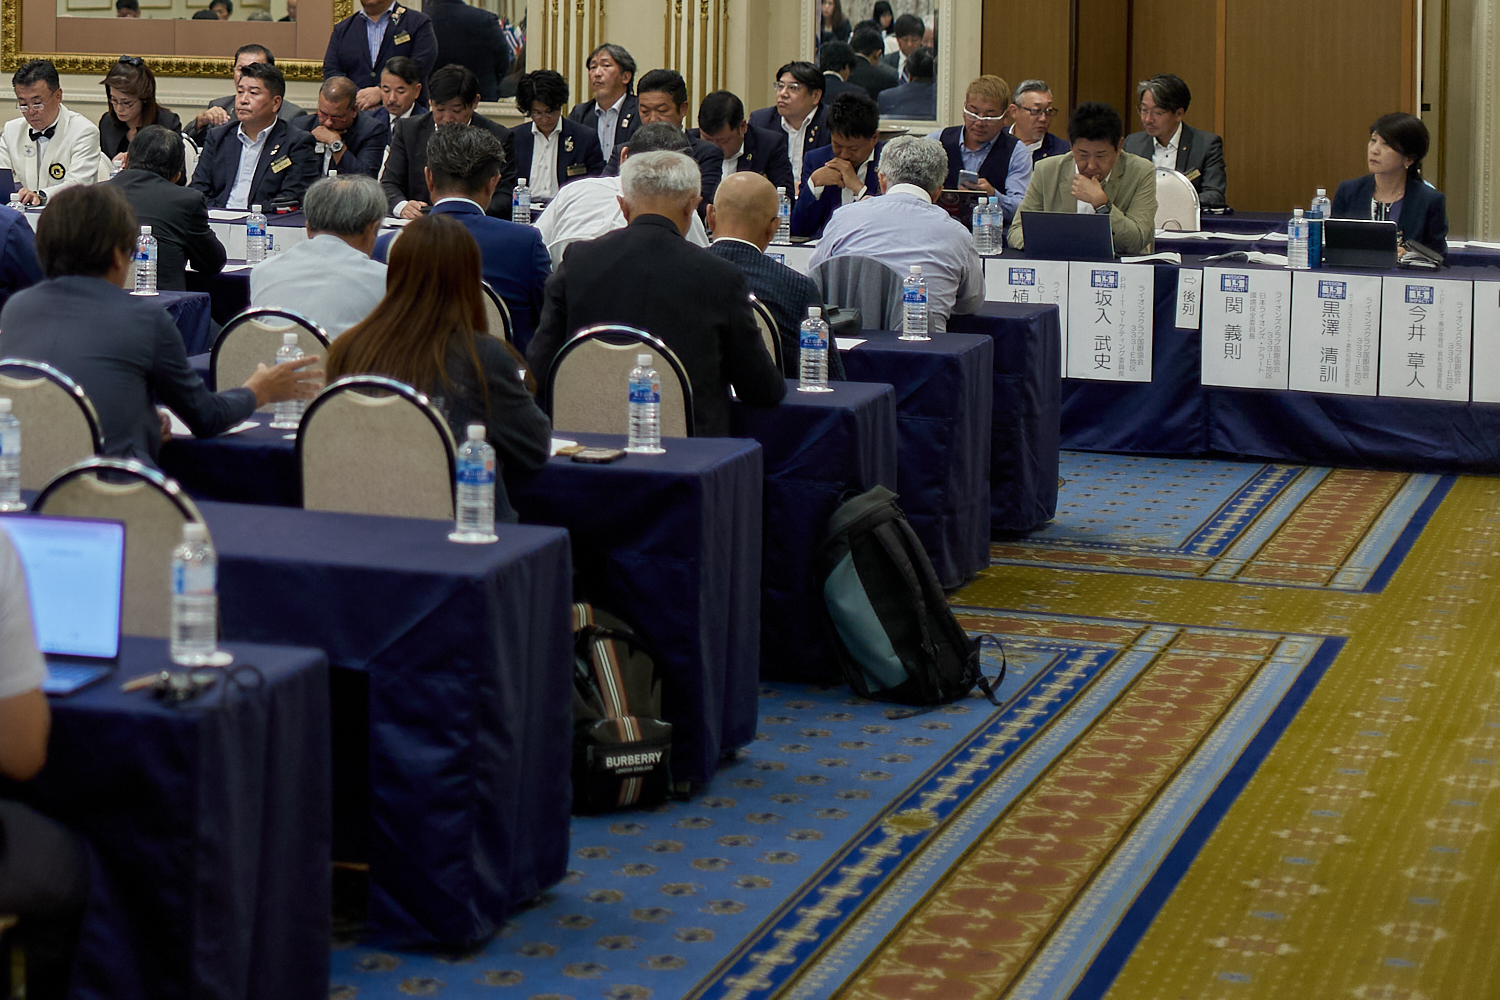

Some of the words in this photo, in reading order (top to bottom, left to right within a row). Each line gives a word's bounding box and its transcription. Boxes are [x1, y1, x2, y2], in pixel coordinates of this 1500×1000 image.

[1094, 289, 1113, 325] 坂入
[1182, 290, 1196, 316] 後列
[1225, 296, 1243, 314] 関
[1321, 300, 1340, 337] 黒澤
[1407, 305, 1427, 342] 今井
[1093, 335, 1112, 370] 武史
[1223, 324, 1243, 360] 義則
[1319, 347, 1339, 383] 清訓
[1406, 352, 1425, 388] 章人
[606, 752, 662, 767] BURBERRY
